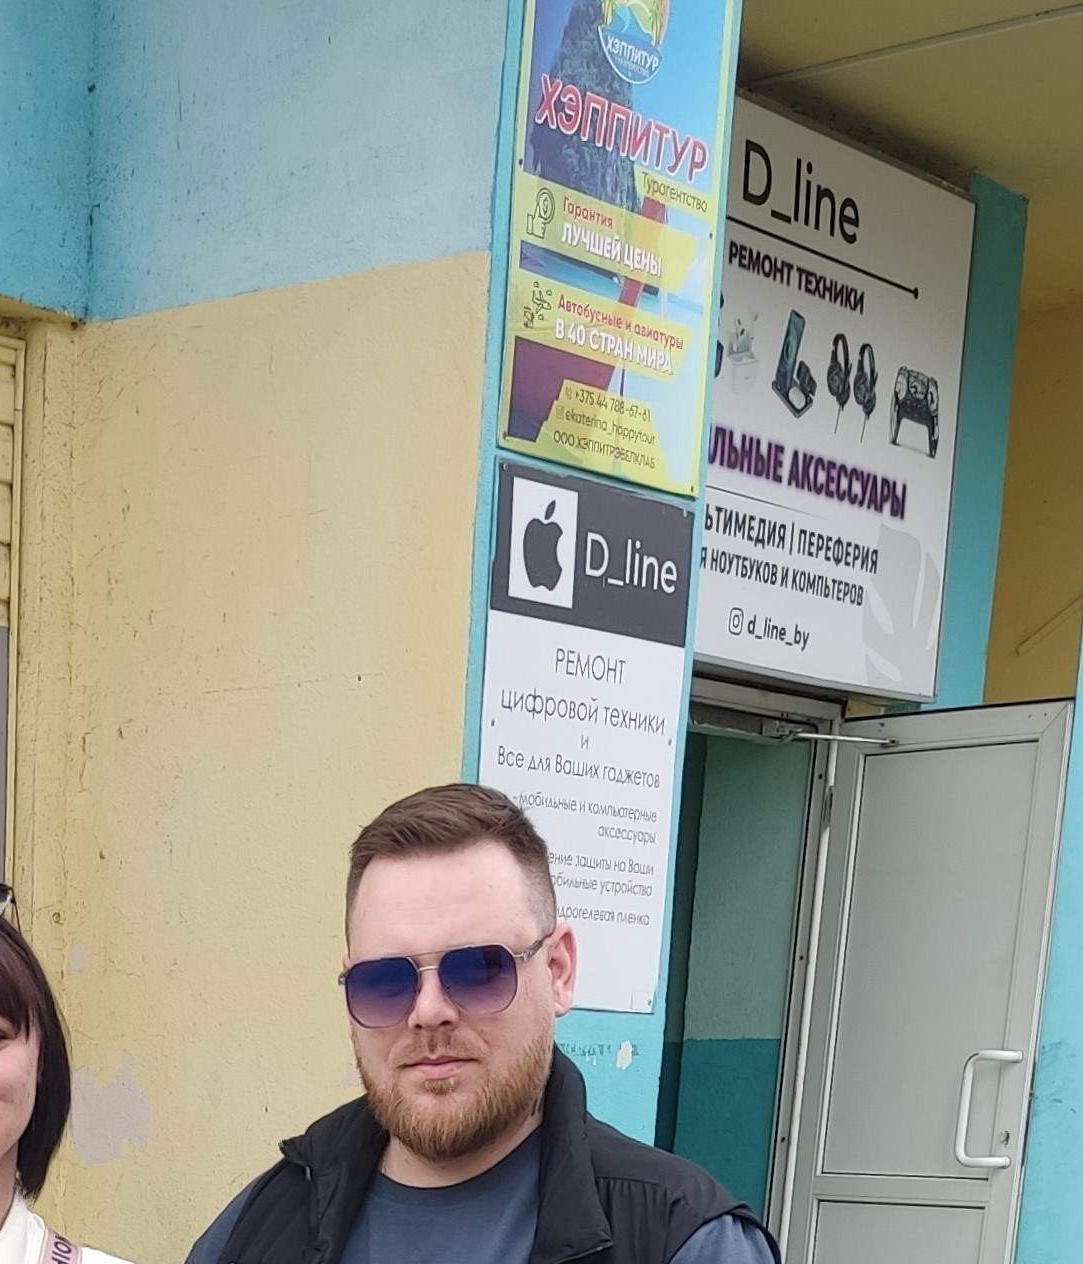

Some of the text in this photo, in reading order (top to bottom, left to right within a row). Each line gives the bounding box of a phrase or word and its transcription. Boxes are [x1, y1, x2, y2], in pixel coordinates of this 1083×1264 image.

[606, 35, 659, 72] ХЭППИТУР
[535, 73, 709, 183] ХЭППИТУР
[563, 197, 613, 228] Гарантия
[642, 171, 708, 213] Турагентство
[743, 139, 859, 244] D_line
[561, 223, 663, 277] ЛУЧШЕЙ ЦЕНЫ
[729, 240, 865, 314] РЕМОНТ ТЕХНИКИ
[558, 294, 683, 350] Автобусные и авиатуры
[555, 318, 673, 375] В 40 СТРАН МИРА
[554, 430, 575, 447] ООО
[708, 424, 907, 520] ЛЬНЫЕ АКСЕССУАРЫ
[585, 532, 678, 594] D_line
[710, 548, 777, 586] НОУТБУКОВ
[780, 566, 789, 588] И
[797, 528, 879, 574] ПЕРЕФЕРИЯ
[747, 615, 810, 651] d_line_by
[555, 648, 626, 684] РЕМОНТ
[501, 688, 666, 735] цифровой техники
[580, 735, 589, 750] и
[498, 745, 660, 789] Все для Ваших гаджетов
[519, 792, 577, 812] мобильные
[579, 800, 586, 813] и
[588, 801, 657, 823] компьютерные
[598, 825, 657, 846] аксессуары
[614, 860, 626, 873] на
[628, 857, 654, 876] Ваши
